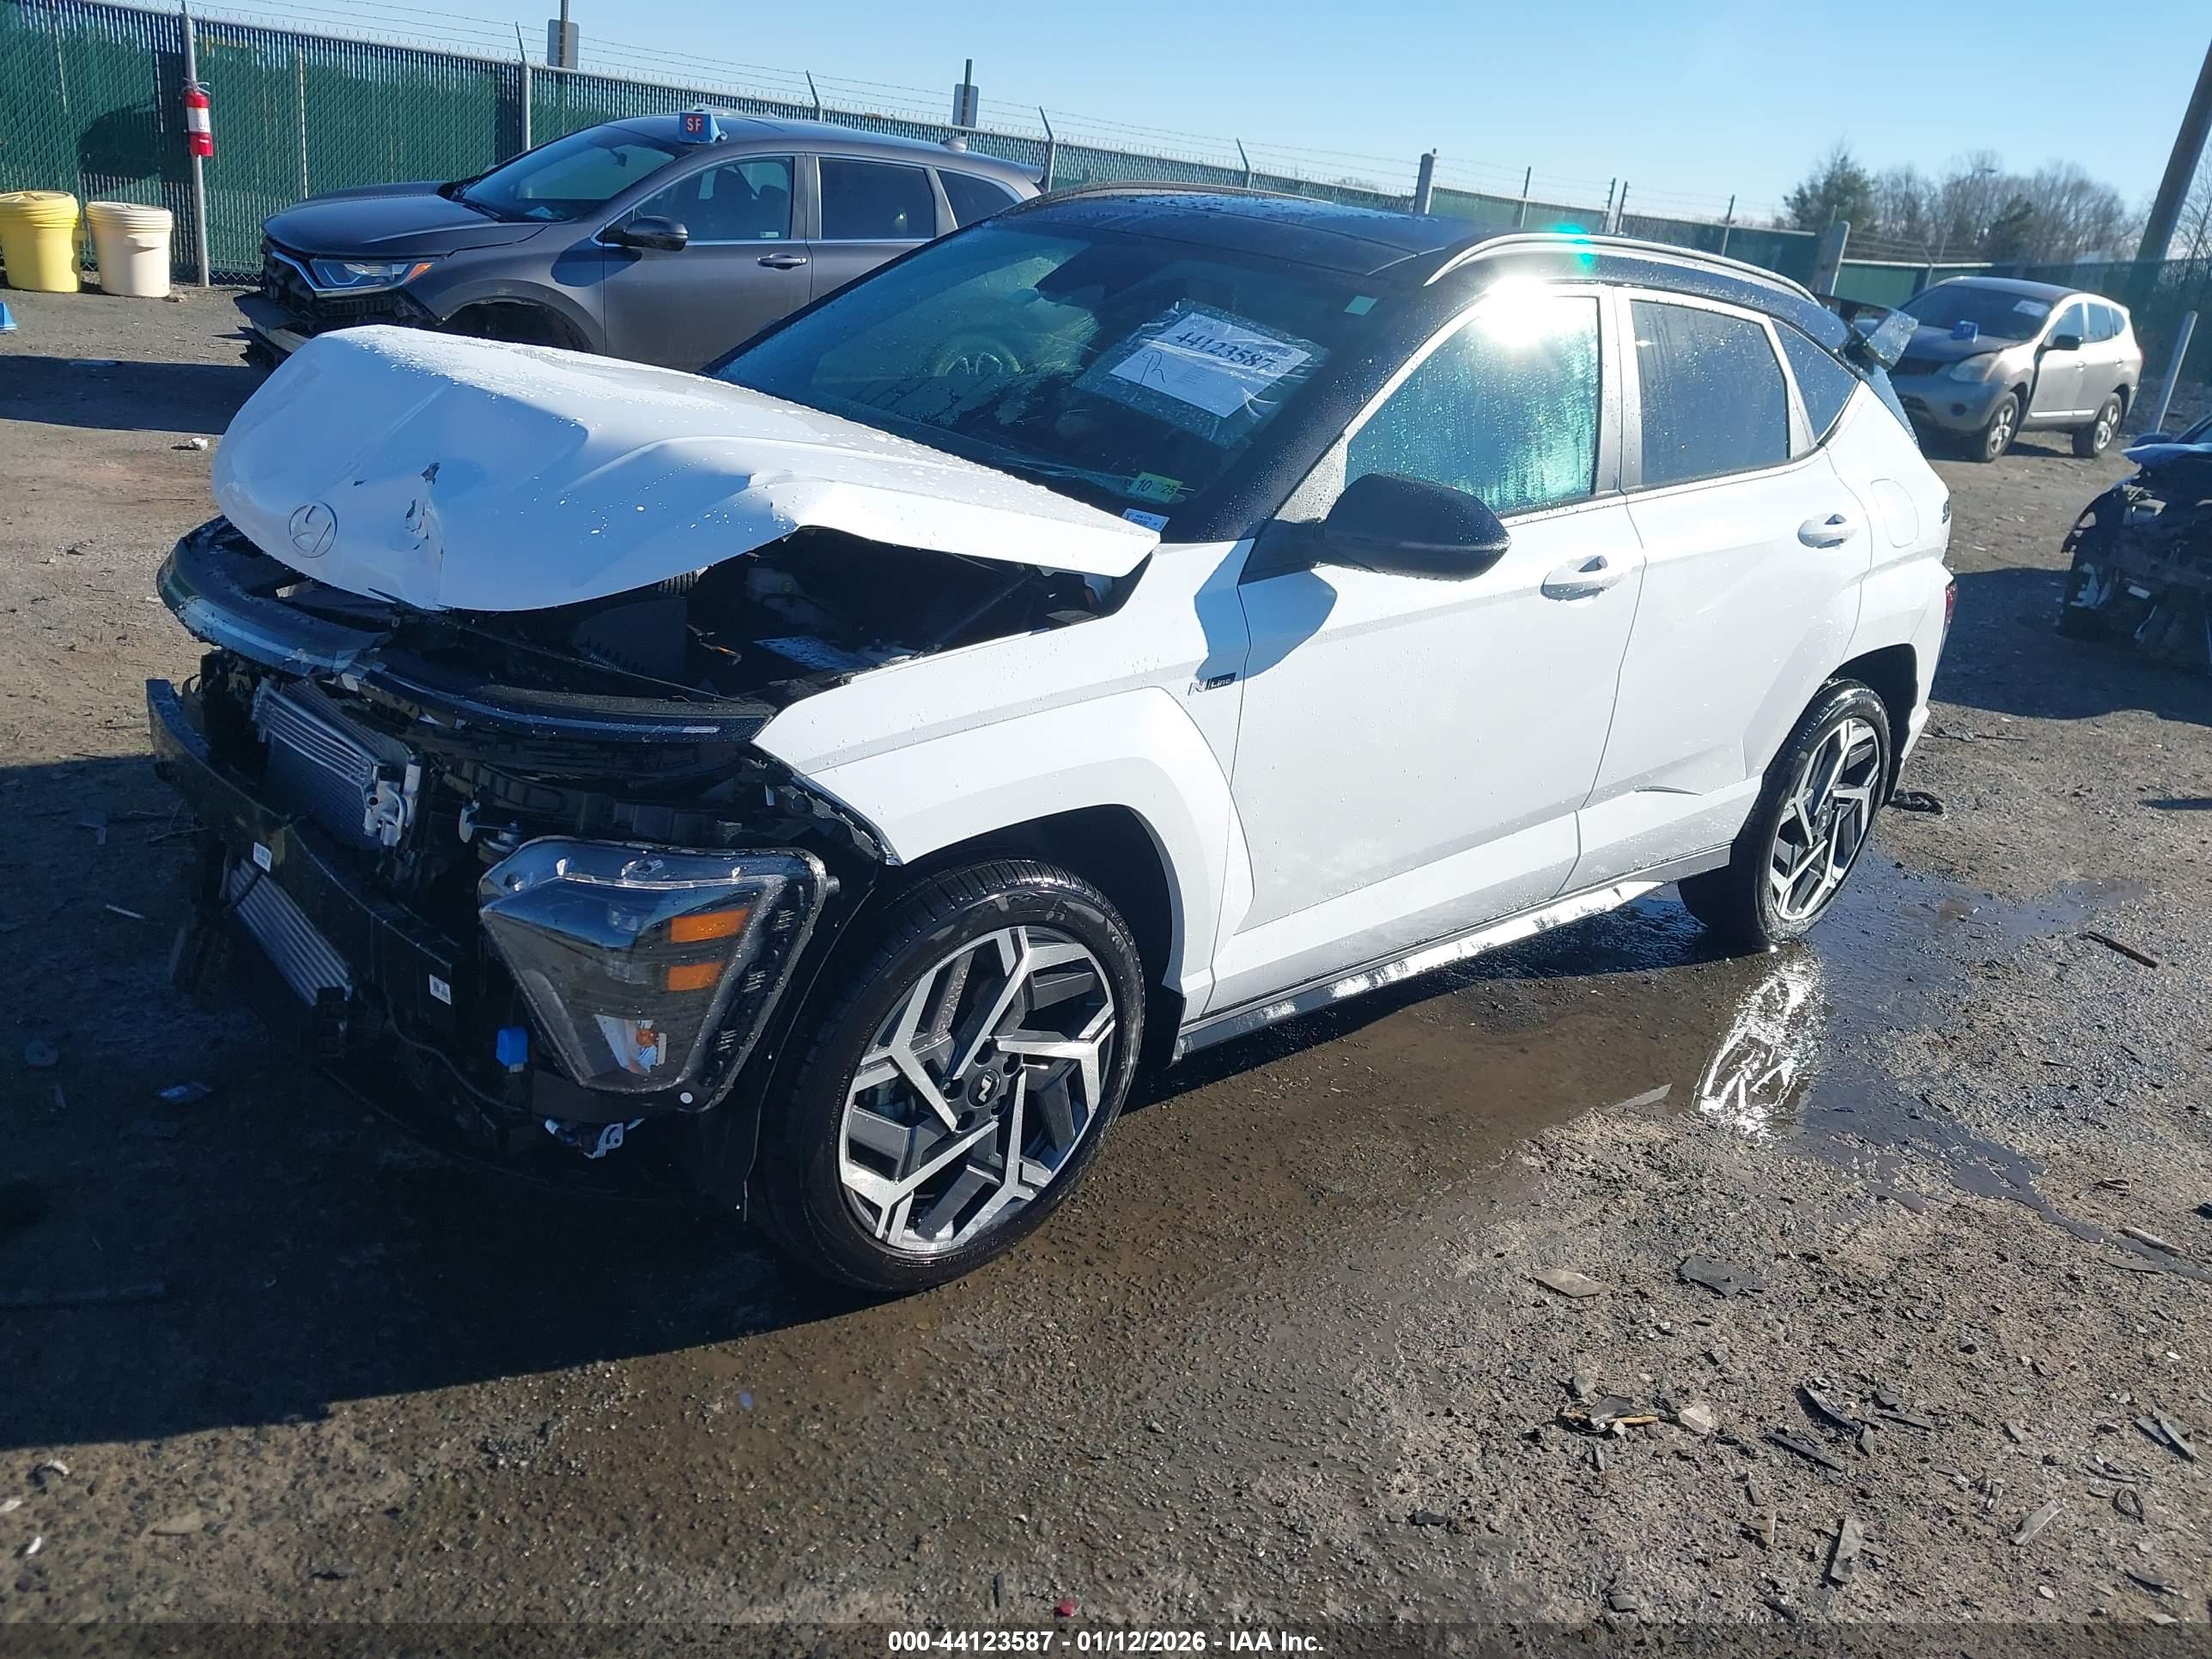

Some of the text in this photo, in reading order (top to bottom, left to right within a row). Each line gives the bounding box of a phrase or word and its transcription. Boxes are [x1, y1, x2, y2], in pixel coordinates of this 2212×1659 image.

[687, 118, 702, 131] SF
[1176, 331, 1278, 371] 44123587
[1136, 479, 1177, 495] 10 25
